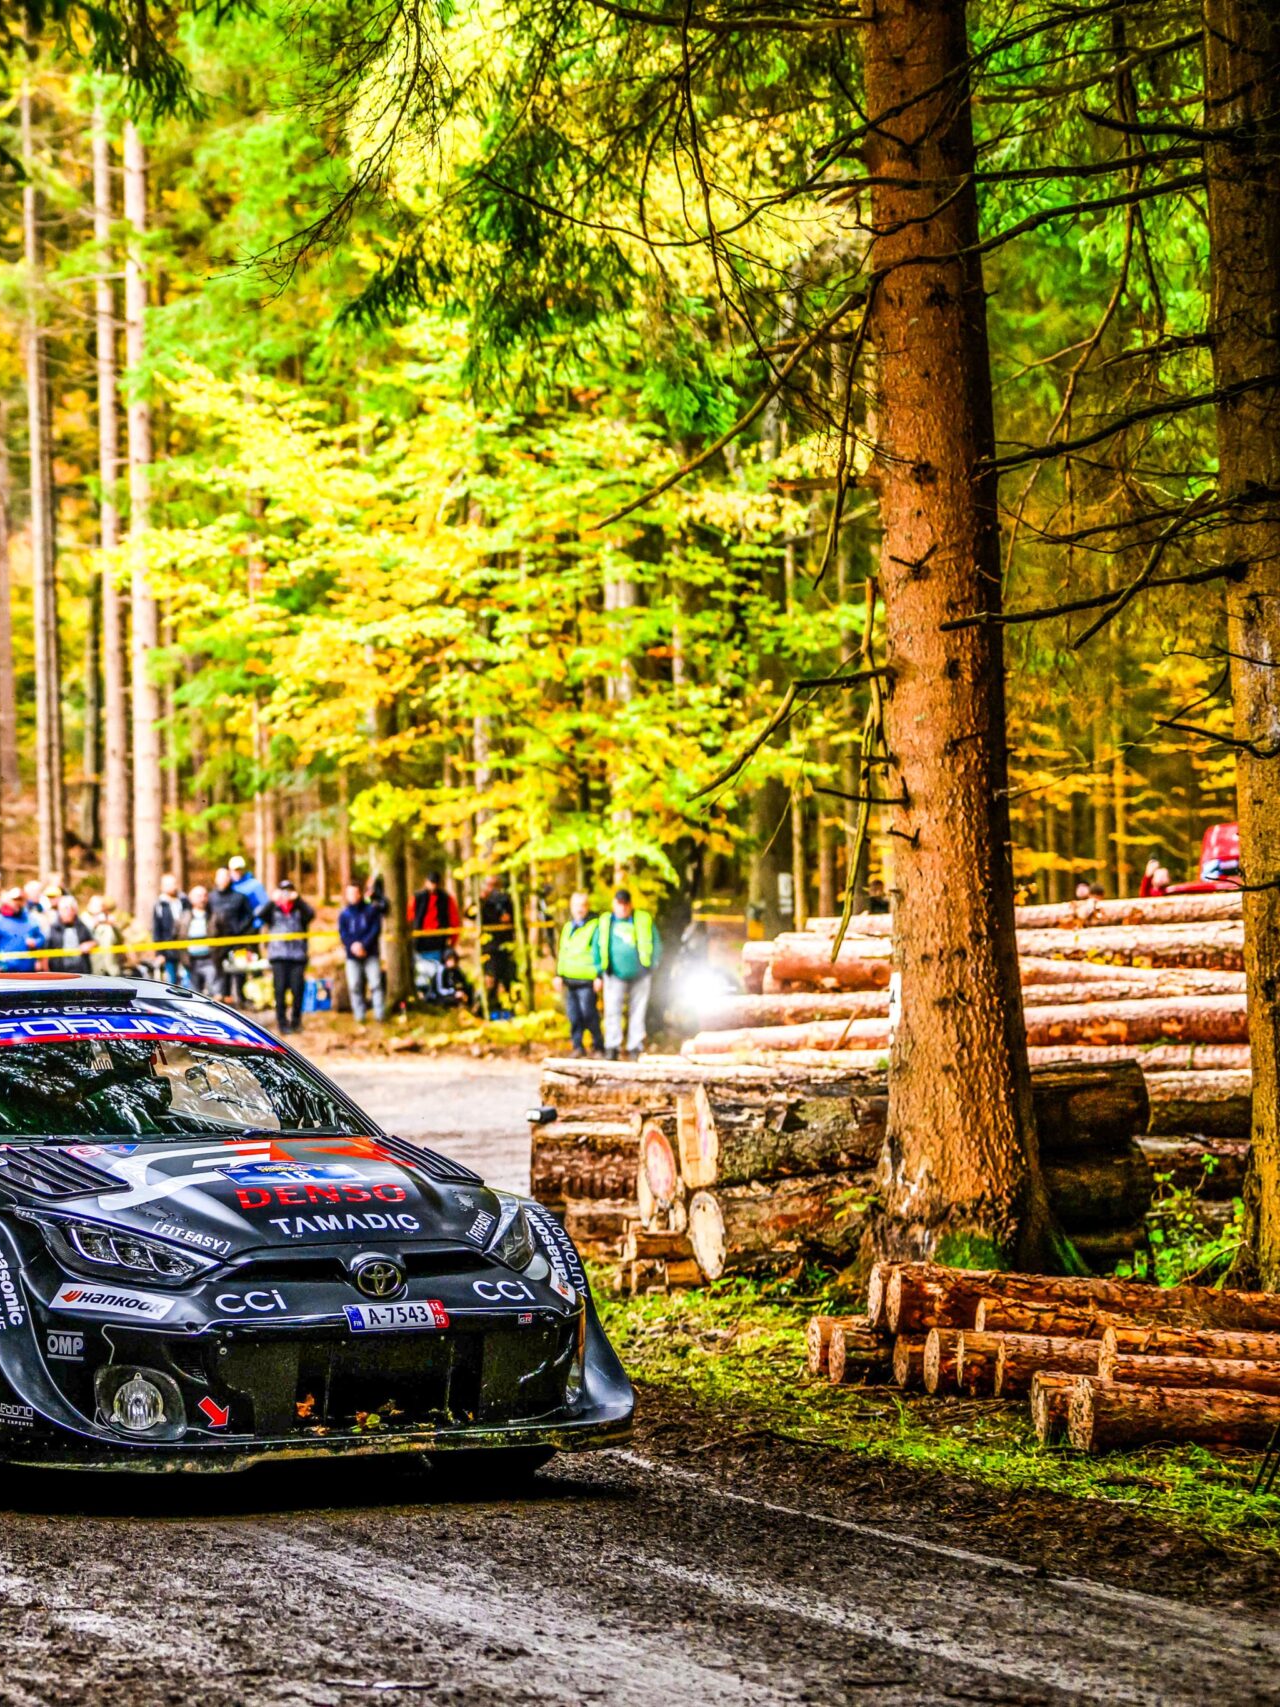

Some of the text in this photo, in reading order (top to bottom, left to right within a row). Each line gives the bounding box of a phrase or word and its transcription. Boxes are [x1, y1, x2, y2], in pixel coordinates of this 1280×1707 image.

[63, 1005, 142, 1015] GAZOO
[278, 1170, 315, 1181] 18
[235, 1183, 407, 1209] DENSO
[269, 1213, 420, 1235] TAMADIC
[532, 1205, 588, 1298] AUTOMOTIVE
[368, 1305, 429, 1325] A-7543
[434, 1314, 445, 1324] 25
[47, 1334, 84, 1355] OMP
